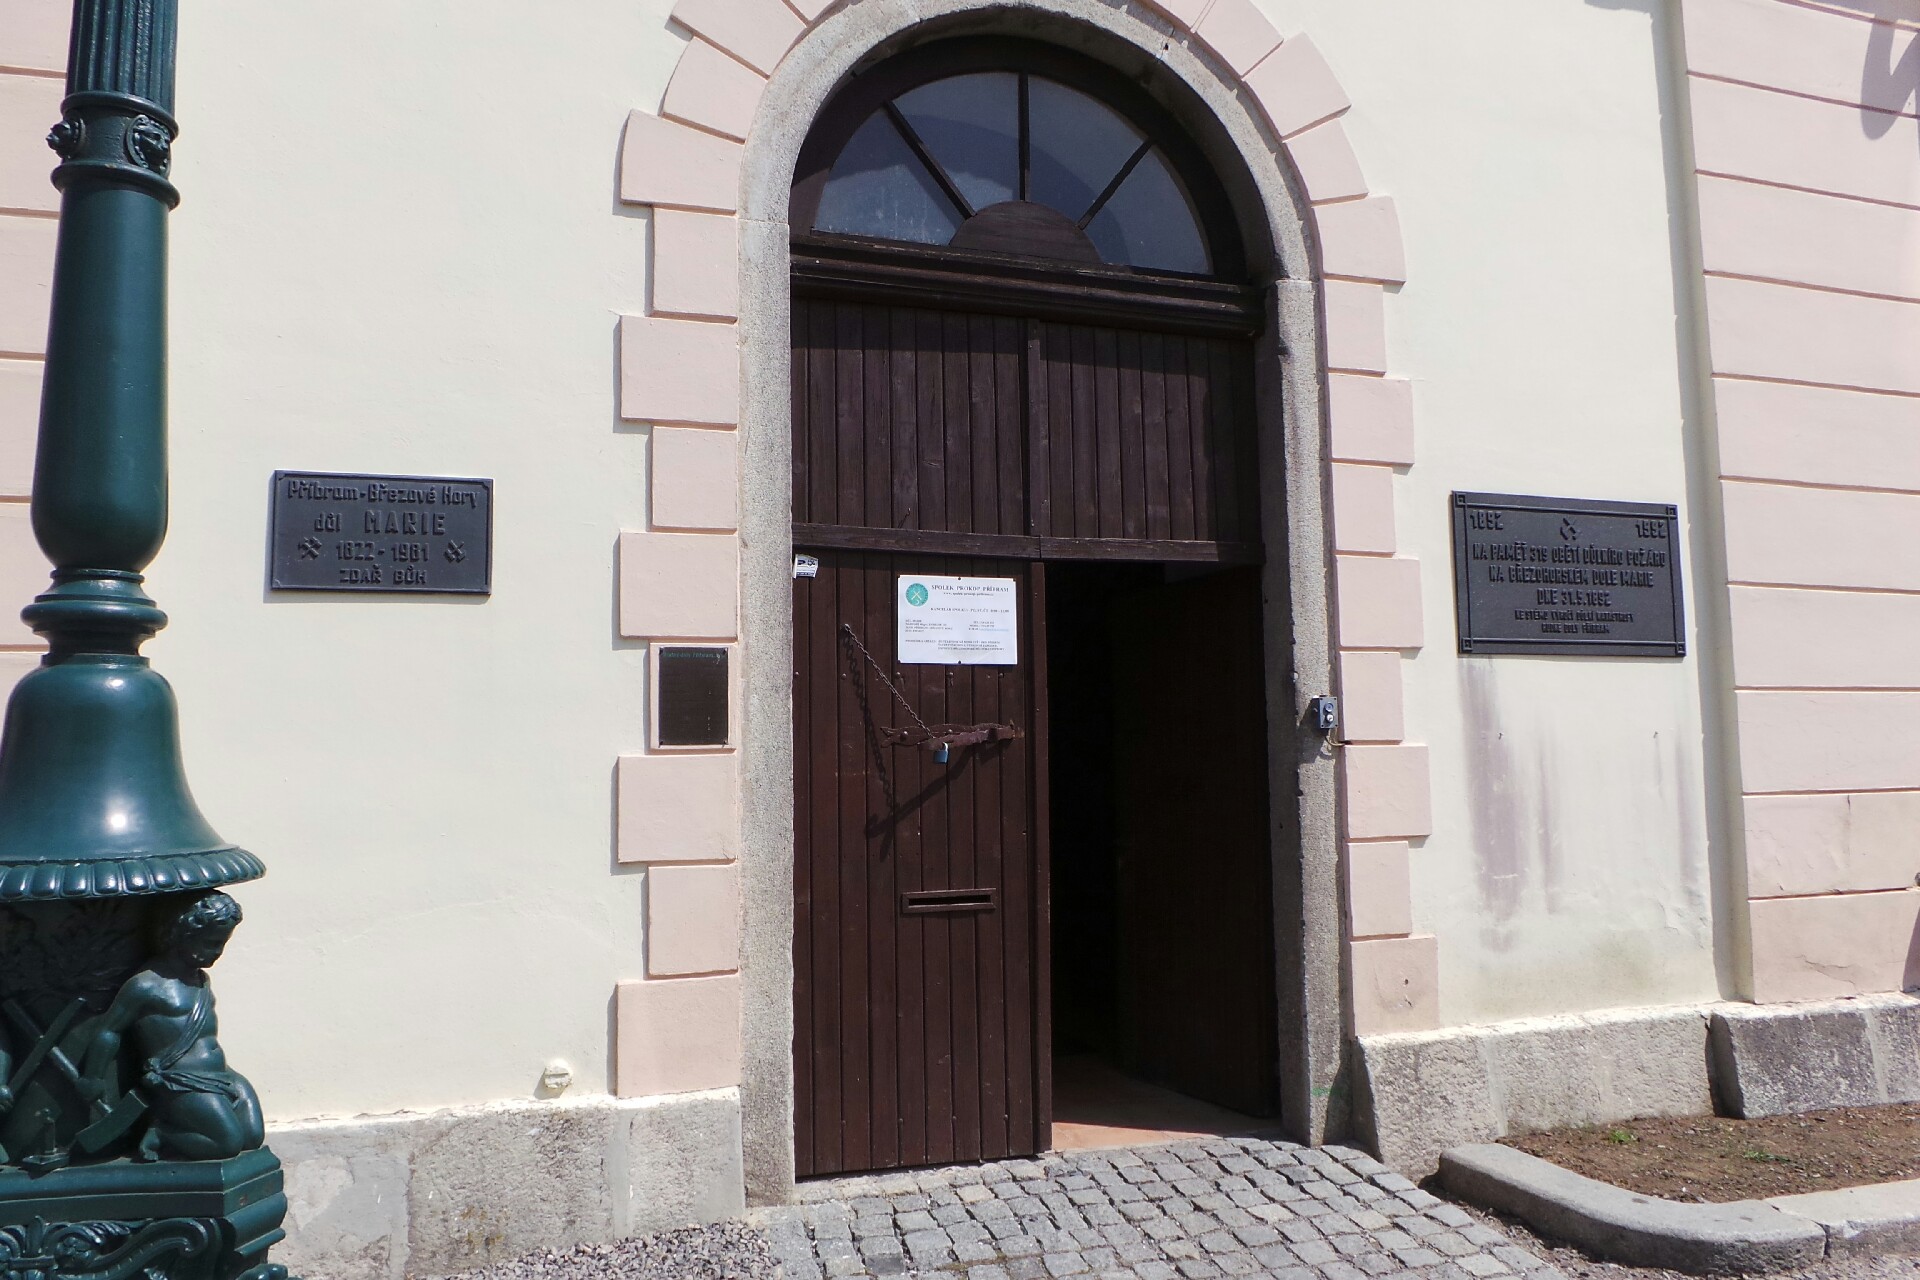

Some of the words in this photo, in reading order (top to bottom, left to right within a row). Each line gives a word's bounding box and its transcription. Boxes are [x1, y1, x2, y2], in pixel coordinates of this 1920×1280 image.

[442, 486, 479, 508] Hory
[314, 512, 342, 532] důl
[364, 509, 446, 536] MARIE
[1470, 510, 1504, 530] 1892
[1635, 519, 1666, 539] 1992
[336, 540, 375, 561] 1822
[391, 542, 430, 562] 1981
[1473, 542, 1488, 561] NA
[1490, 541, 1528, 561] PAMĚŤ
[1529, 545, 1548, 562] 319
[1551, 543, 1581, 563] OBĚTÍ
[1583, 543, 1623, 566] DŮLNÍHO
[1626, 547, 1666, 567] POŽÁRU
[339, 563, 383, 585] ZDAŘ
[392, 564, 428, 585] BŮH
[1489, 564, 1505, 583] NA
[1592, 568, 1618, 587] DOLE
[1620, 569, 1654, 588] MARIE
[1536, 587, 1559, 606] DNE
